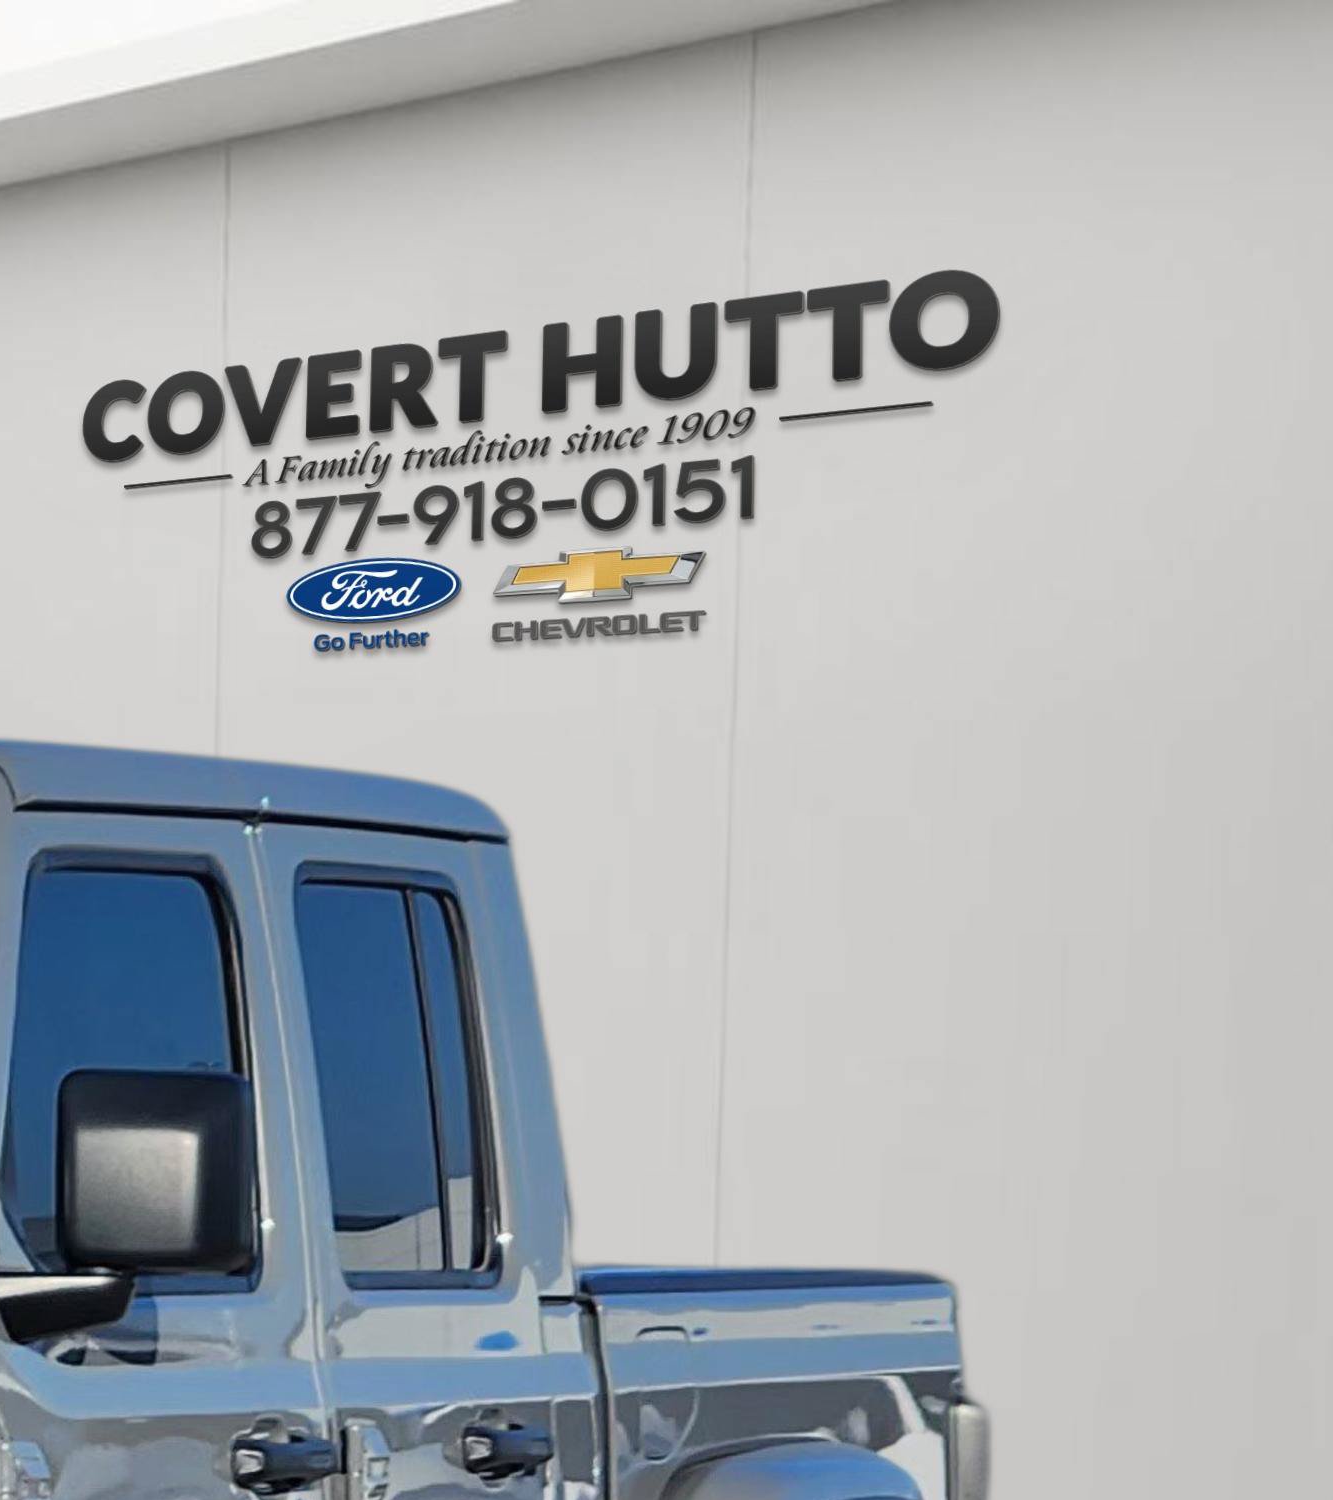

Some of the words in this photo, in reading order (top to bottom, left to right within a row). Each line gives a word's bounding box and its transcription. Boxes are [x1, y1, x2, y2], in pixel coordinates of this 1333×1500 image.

[82, 331, 508, 464] COVERT
[542, 270, 1001, 415] HUTTO
[242, 458, 269, 488] A
[275, 441, 393, 489] Family
[402, 430, 552, 472] tradition
[561, 422, 649, 456] since
[657, 406, 756, 446] 1909
[250, 454, 756, 560] 877-918-0151
[320, 568, 422, 611] Ford
[313, 634, 346, 653] Go
[349, 629, 430, 651] Further
[491, 610, 707, 643] CHEVROLET
